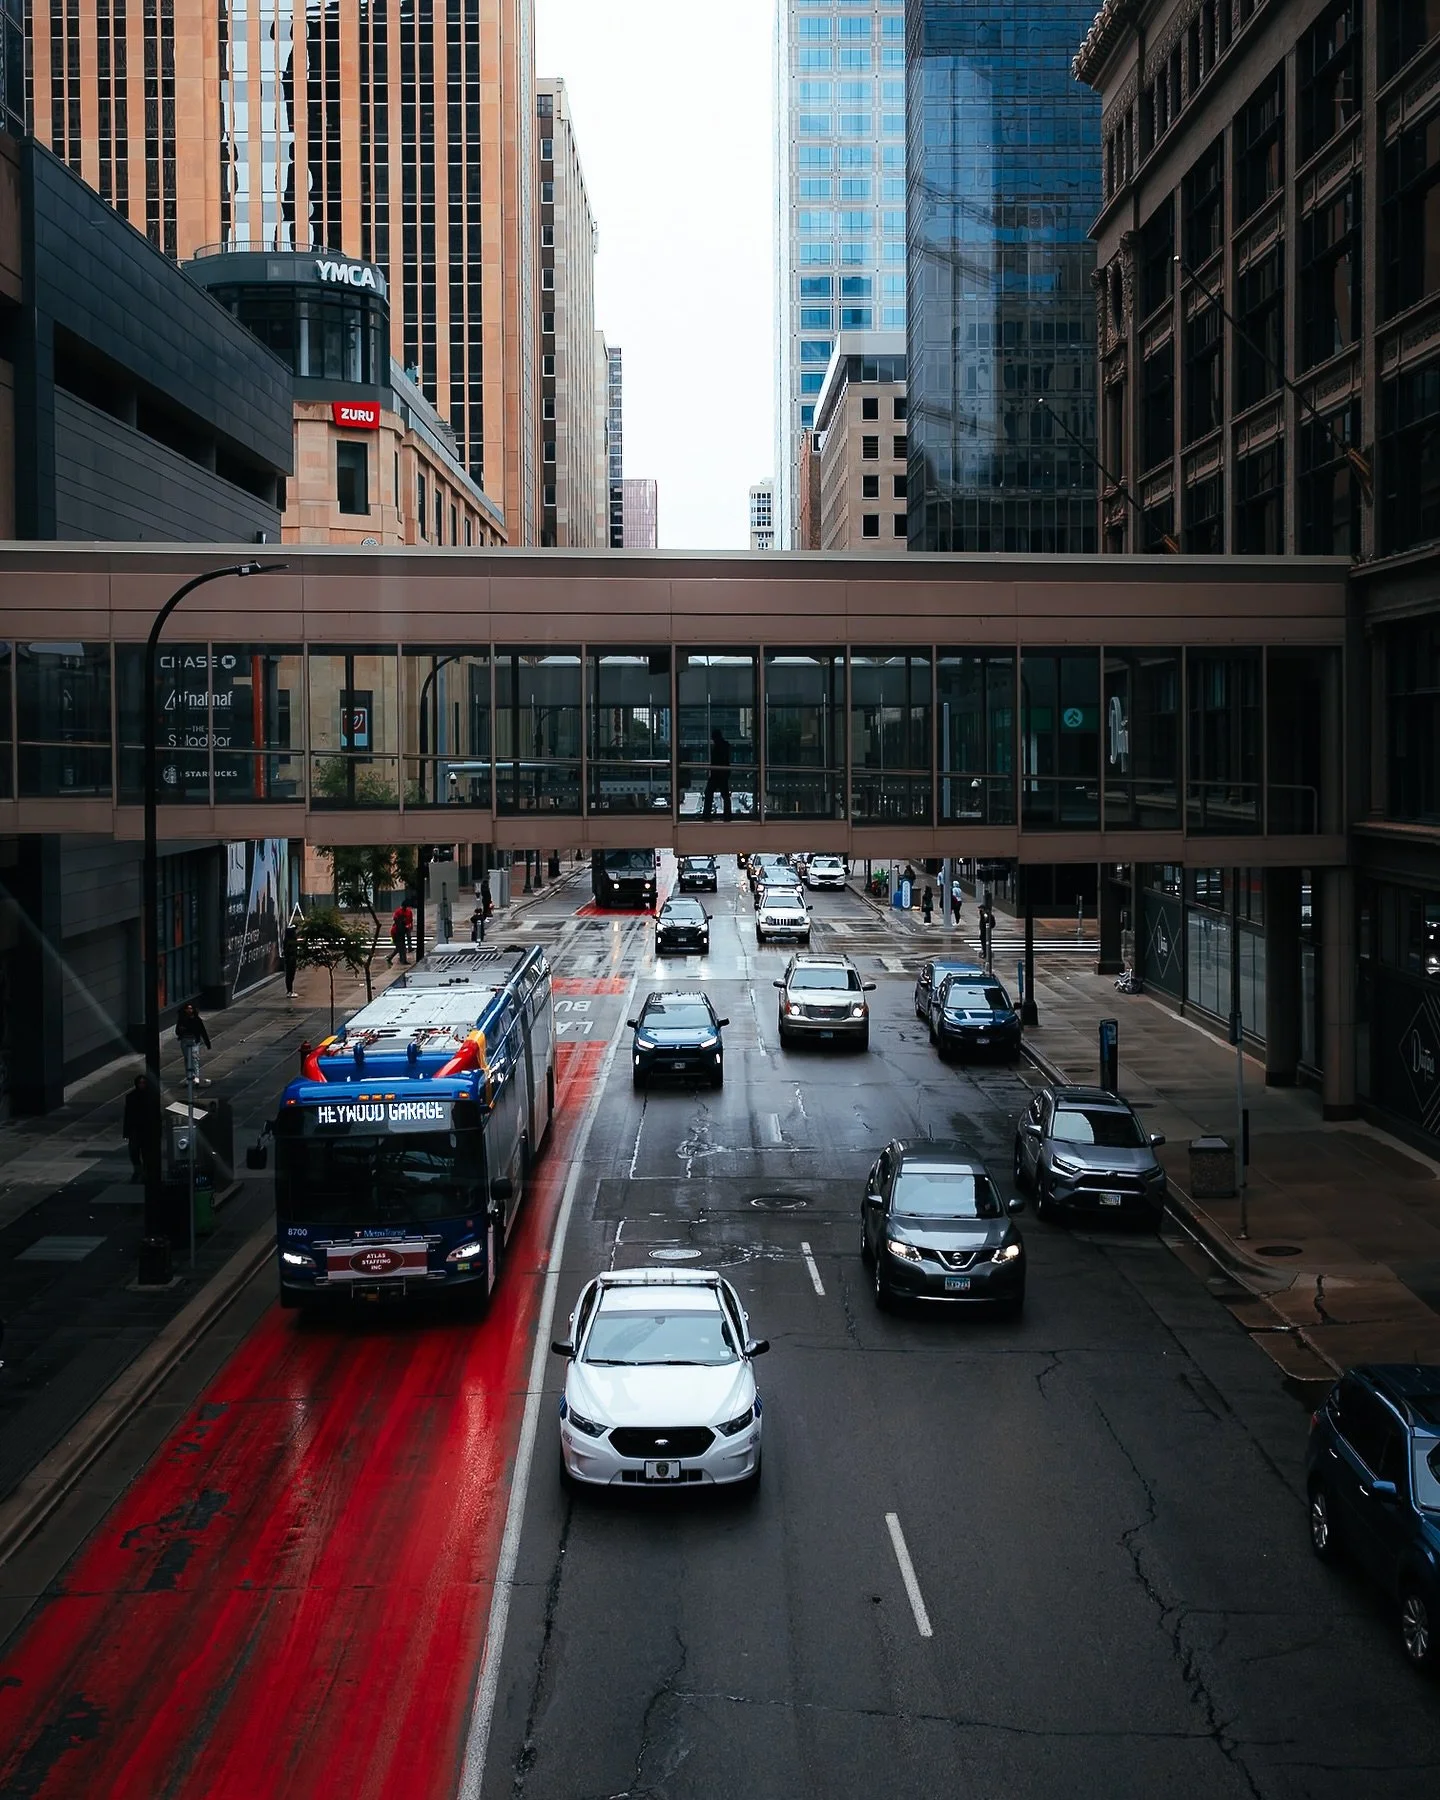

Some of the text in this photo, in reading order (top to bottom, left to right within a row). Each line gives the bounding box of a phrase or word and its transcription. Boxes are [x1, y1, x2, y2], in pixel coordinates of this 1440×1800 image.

[315, 259, 376, 288] YMCA
[341, 407, 374, 423] ZURU
[184, 770, 238, 778] STARUCKS
[318, 1101, 445, 1124] HEYWOOD GARAGE
[287, 1227, 308, 1237] 8700
[361, 1258, 392, 1266] STAFFING
